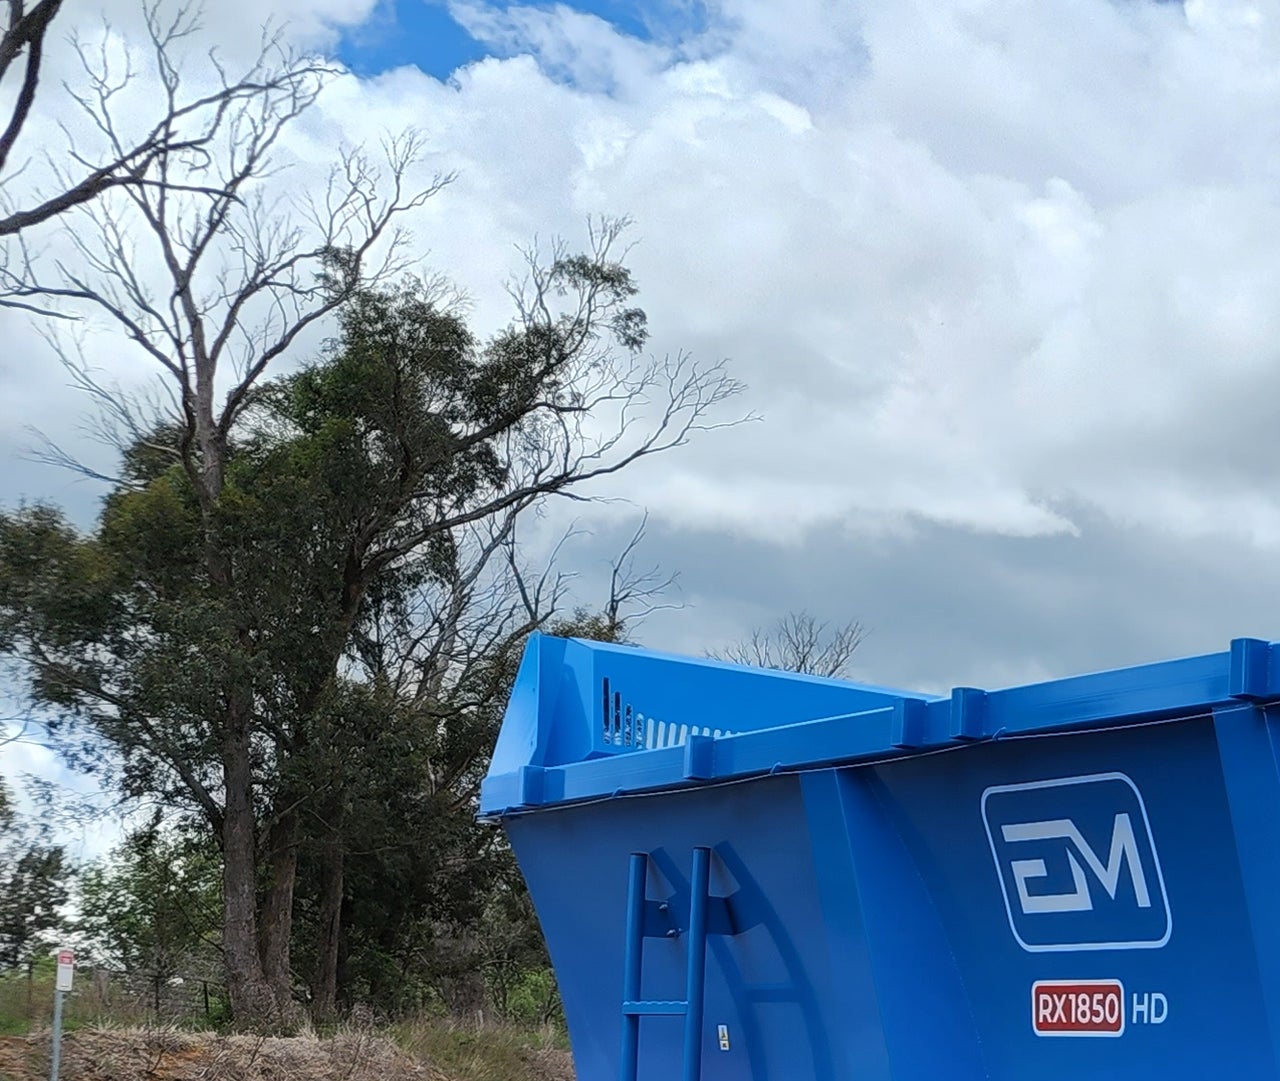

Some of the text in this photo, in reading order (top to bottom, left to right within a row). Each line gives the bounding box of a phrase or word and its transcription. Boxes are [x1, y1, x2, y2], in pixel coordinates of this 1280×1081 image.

[1001, 813, 1151, 914] EM
[1038, 993, 1168, 1024] RX1850 HD
